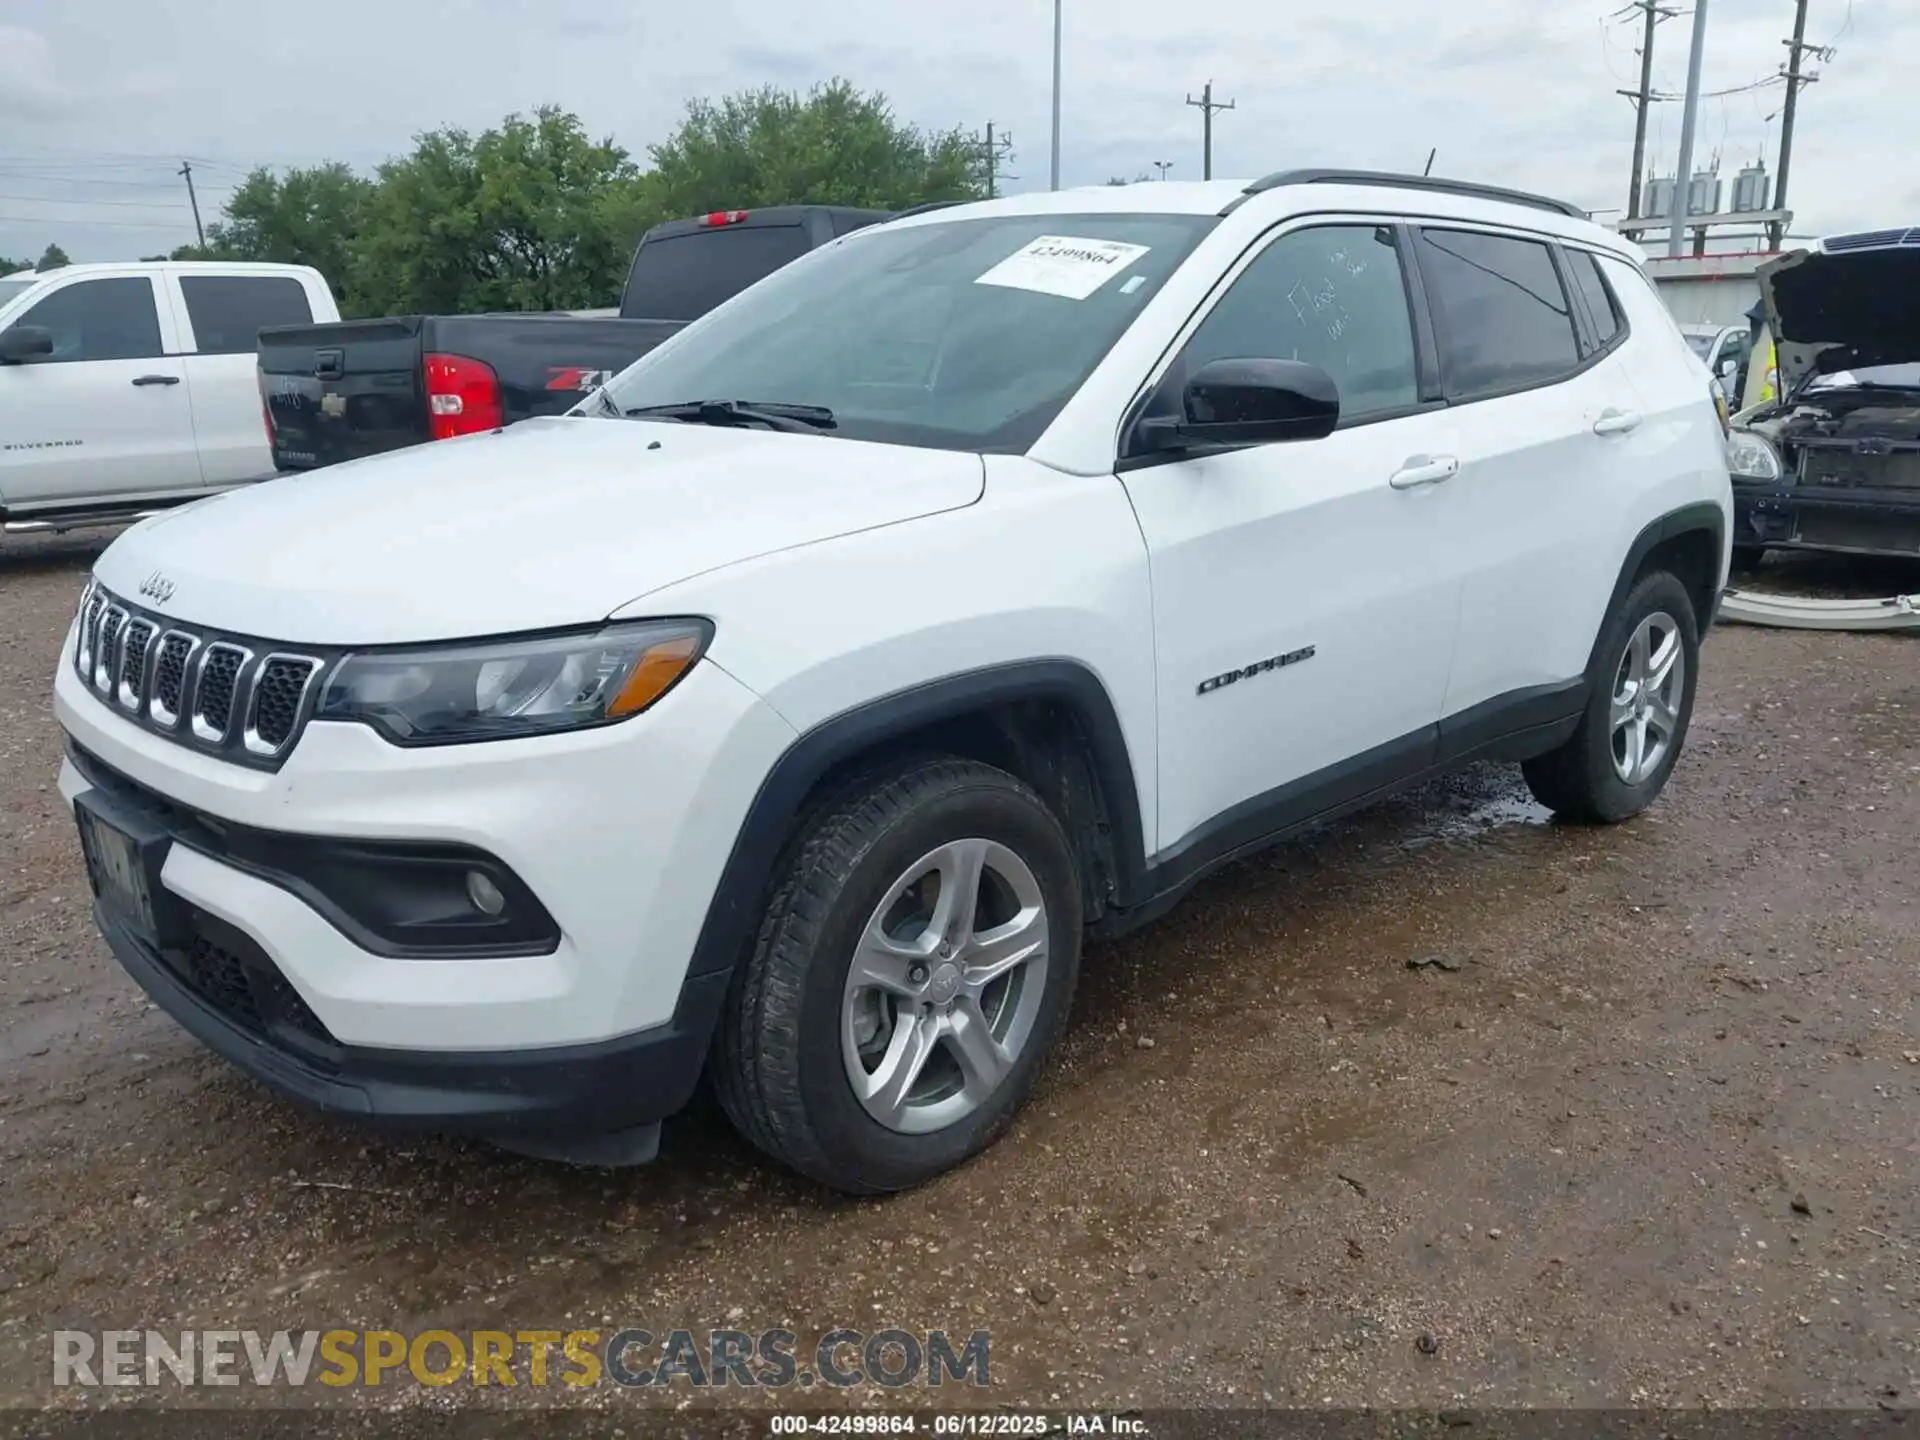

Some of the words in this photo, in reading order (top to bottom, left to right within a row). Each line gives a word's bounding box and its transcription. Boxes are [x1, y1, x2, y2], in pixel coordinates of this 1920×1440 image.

[3, 439, 84, 451] SILVERADO
[139, 569, 178, 607] Jeep
[1196, 644, 1316, 696] COMPASS
